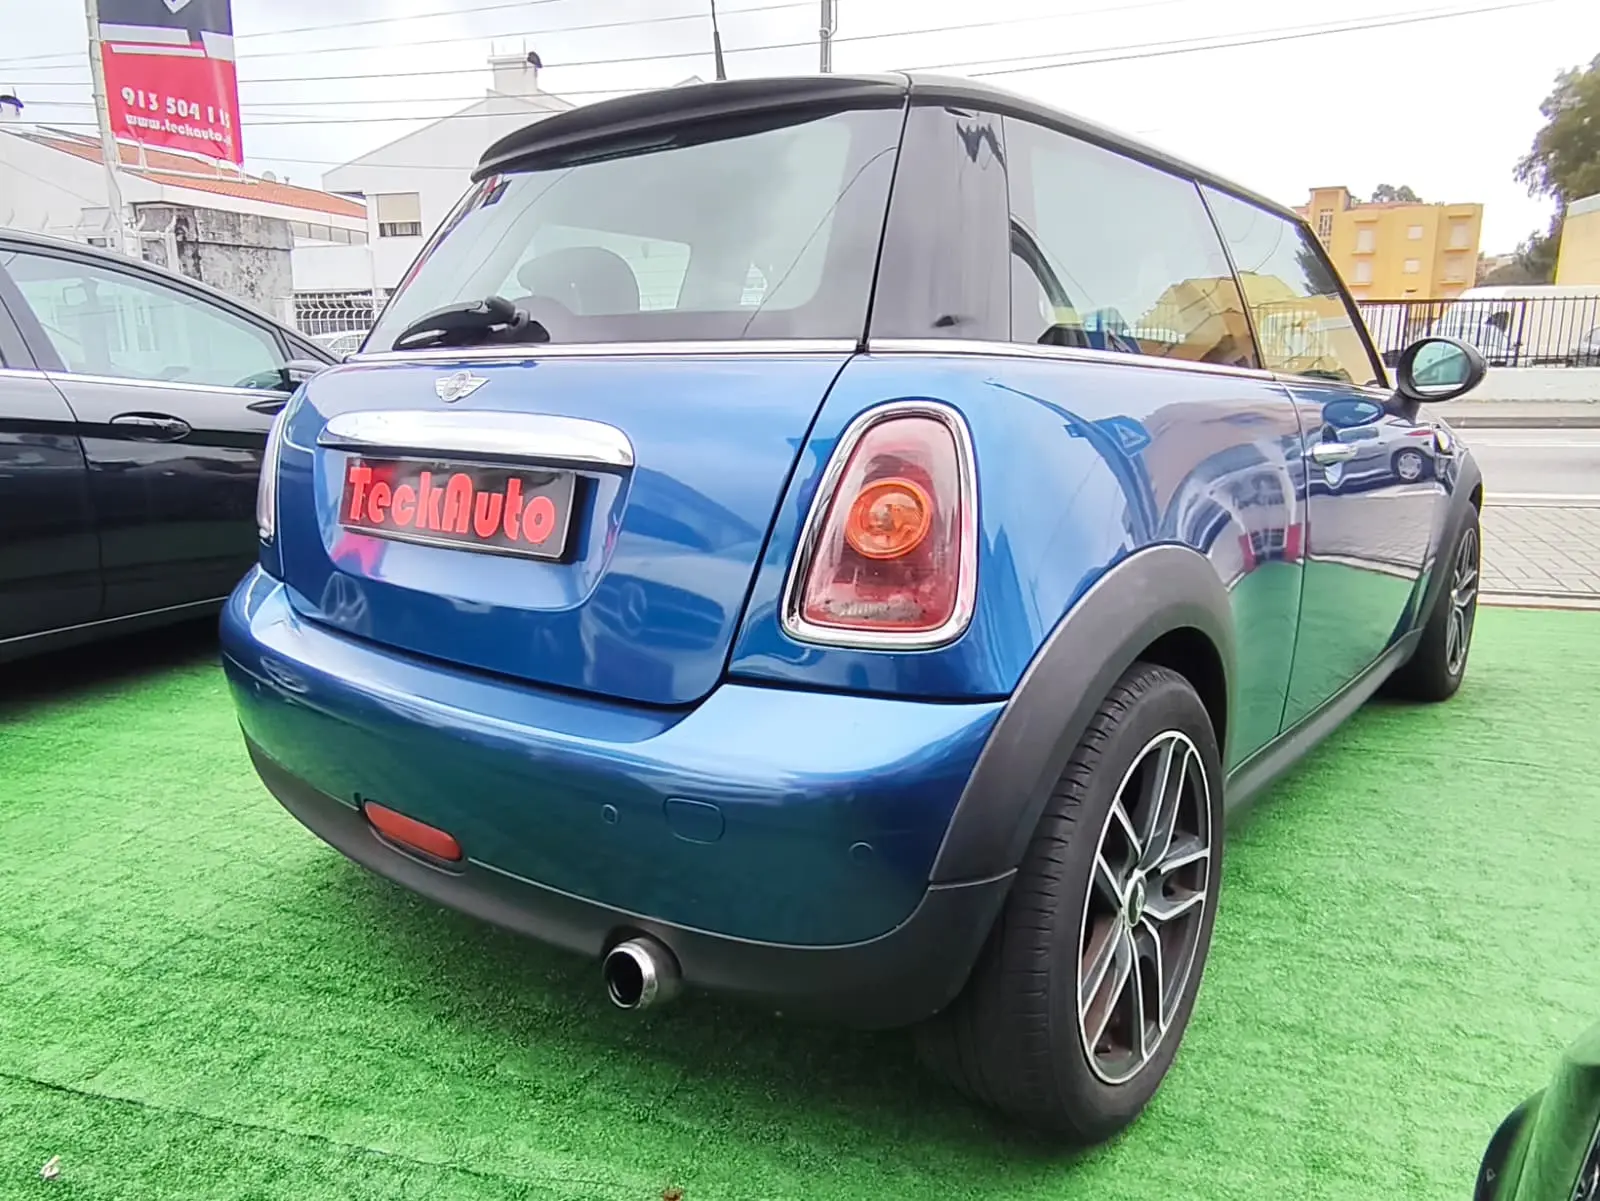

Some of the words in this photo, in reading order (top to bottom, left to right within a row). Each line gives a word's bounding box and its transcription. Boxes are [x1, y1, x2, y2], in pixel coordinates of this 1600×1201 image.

[121, 86, 158, 110] 913
[166, 96, 200, 120] 504
[349, 467, 555, 544] TeckAuto
